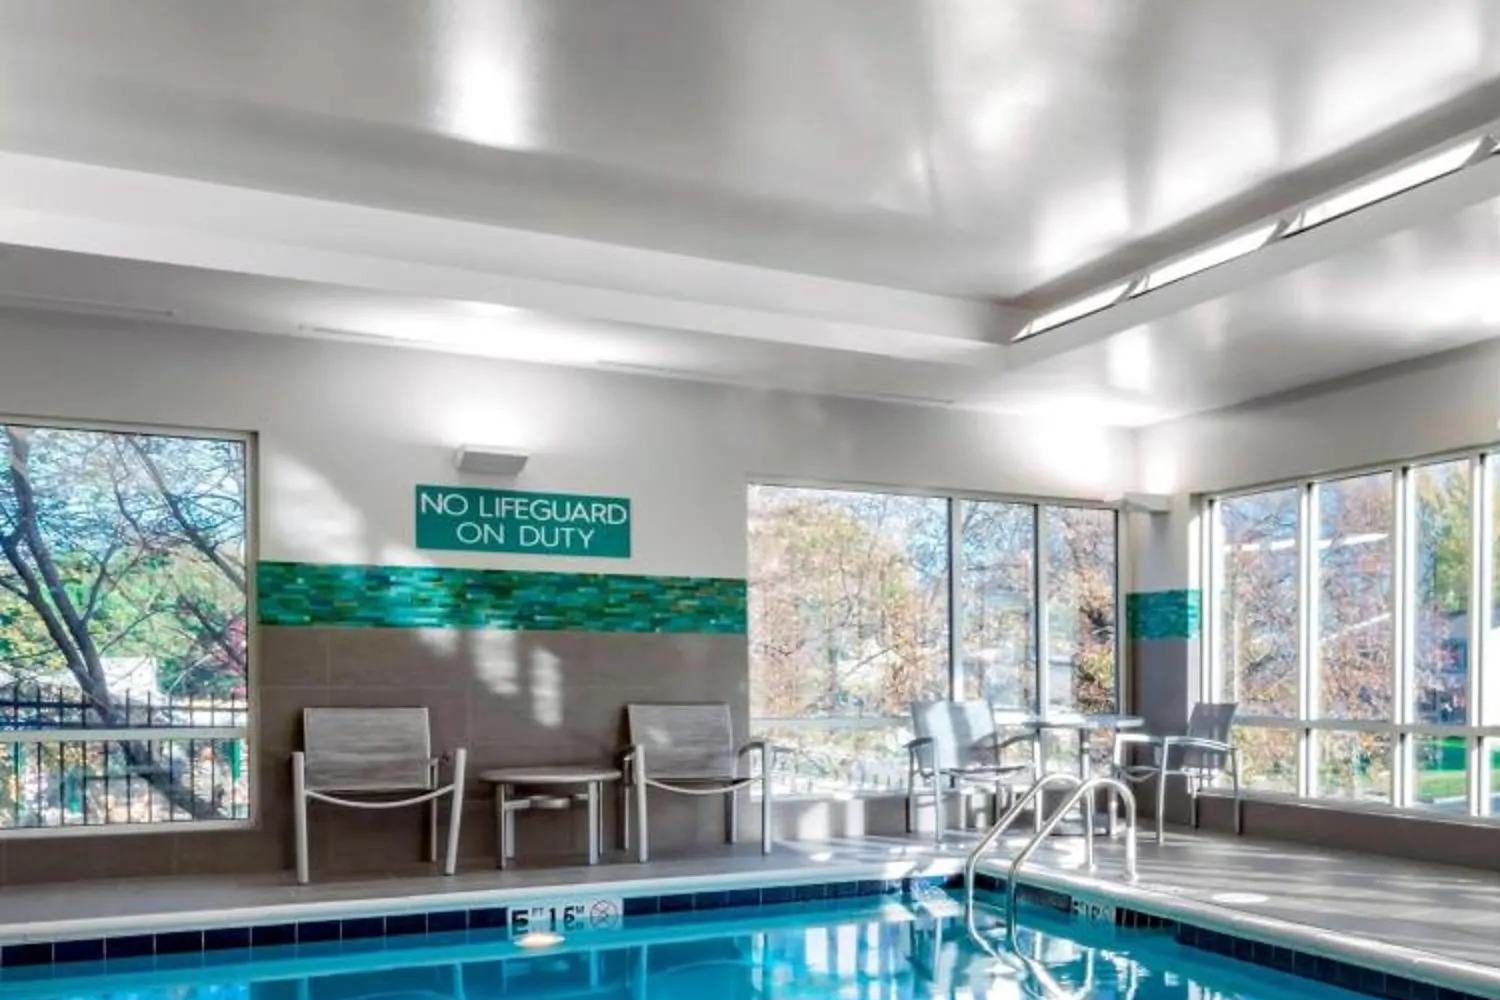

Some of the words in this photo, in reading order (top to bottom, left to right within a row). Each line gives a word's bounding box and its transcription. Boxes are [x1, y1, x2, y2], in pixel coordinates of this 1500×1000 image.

[420, 492, 469, 517] NO
[479, 496, 628, 526] LIFEGUARD
[456, 521, 505, 545] ON
[519, 525, 596, 549] DUTY
